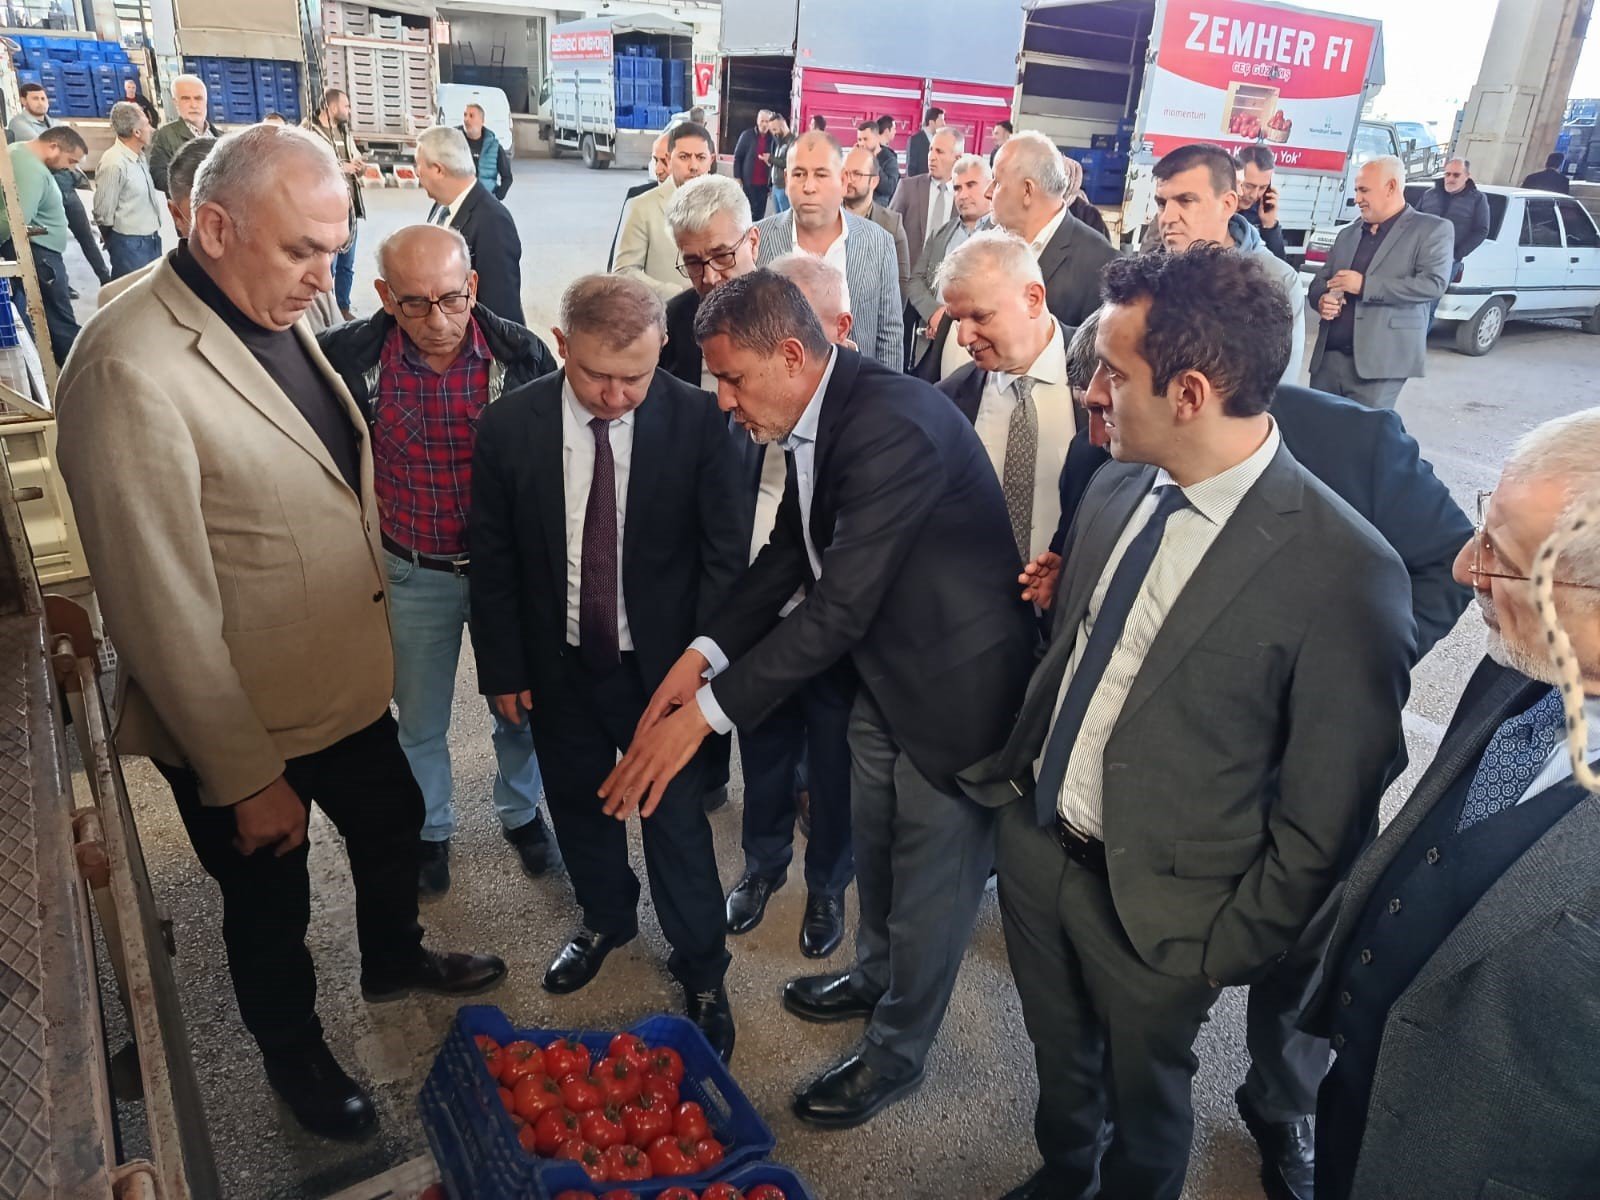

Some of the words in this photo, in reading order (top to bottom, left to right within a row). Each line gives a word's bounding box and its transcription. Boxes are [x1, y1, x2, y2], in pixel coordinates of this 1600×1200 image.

[1185, 12, 1316, 67] ZEMHER
[1323, 36, 1354, 73] F1
[1232, 61, 1251, 77] GEÇ
